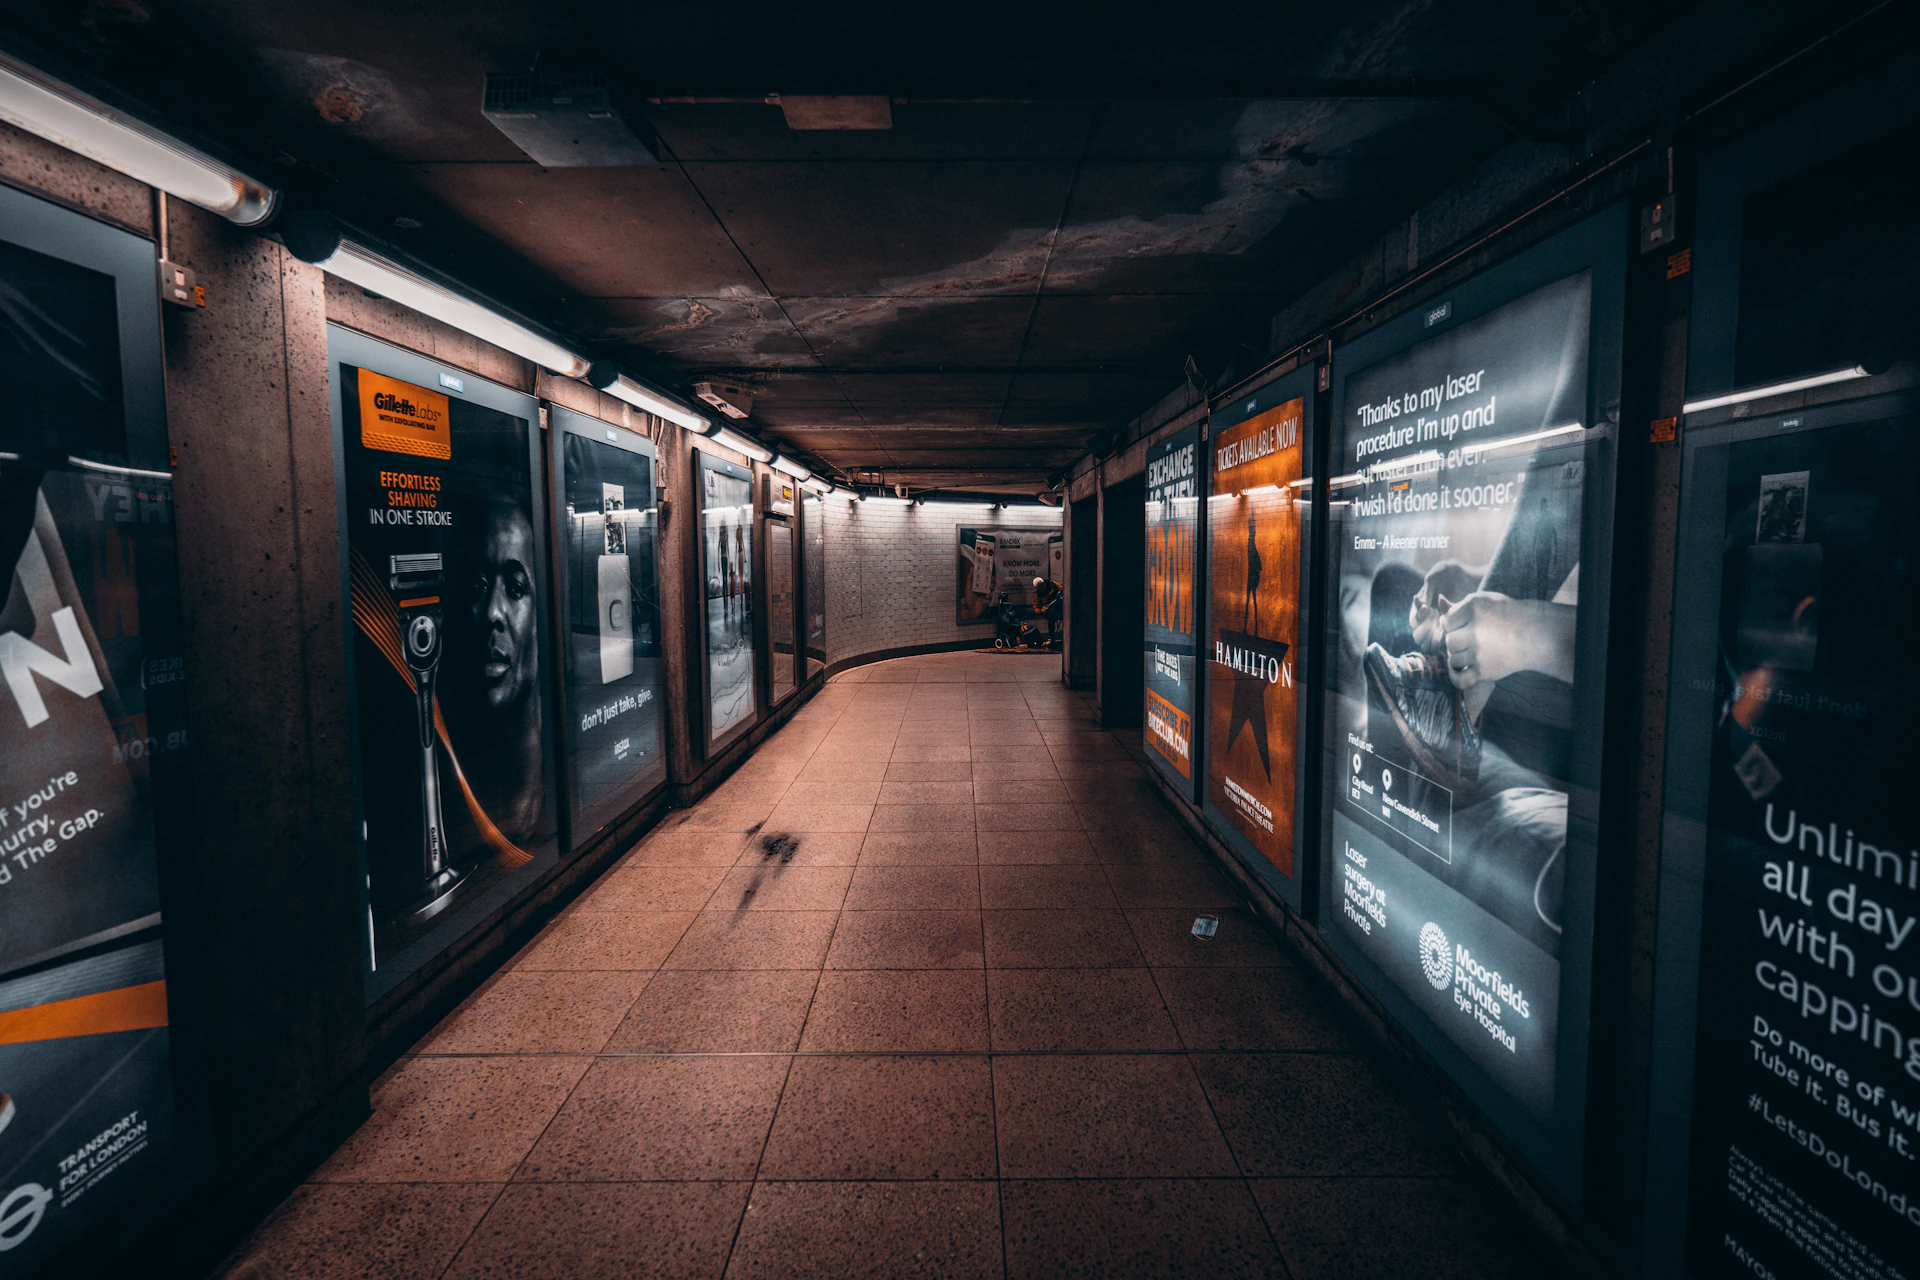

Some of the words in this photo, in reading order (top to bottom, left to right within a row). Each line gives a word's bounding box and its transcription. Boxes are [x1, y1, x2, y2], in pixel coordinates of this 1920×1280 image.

[1403, 392, 1418, 415] to
[1420, 383, 1444, 412] my
[1445, 369, 1485, 401] laser
[378, 413, 394, 423] WITH
[394, 416, 426, 429] EXFOLIATING
[426, 423, 436, 431] BAR
[1217, 441, 1238, 472] TICKETS
[1239, 425, 1275, 465] AVAILABLE
[1276, 416, 1298, 451] NOW
[1355, 425, 1414, 463] procedure
[1416, 417, 1438, 443] I'm
[1440, 414, 1459, 441] up
[1461, 395, 1496, 431] and
[380, 470, 441, 492] EFFORTLESS
[1148, 443, 1194, 489] EXCHANGE
[369, 508, 384, 525] IN
[386, 508, 414, 525] ONE
[416, 510, 453, 526] STROKE
[388, 491, 438, 509] SHAVING
[1164, 478, 1195, 520] THEY
[1359, 492, 1386, 516] wish
[1387, 490, 1401, 514] I'd
[1404, 488, 1438, 513] done
[1440, 485, 1451, 509] it
[1354, 535, 1376, 550] Emma
[1382, 535, 1390, 549] A
[1390, 535, 1418, 549] keener
[1420, 535, 1450, 549] runner
[1008, 570, 1018, 578] DO
[1147, 521, 1193, 636] GROW
[1215, 640, 1292, 689] HAMILTON
[581, 708, 603, 732] don't
[603, 701, 619, 725] just
[619, 695, 637, 714] take,
[637, 689, 653, 708] give.
[1148, 693, 1178, 733] SUBSCRIBE
[1180, 717, 1189, 742] AT
[1148, 710, 1189, 761] BIKECLUB.COM
[1348, 732, 1360, 744] Find
[1360, 740, 1366, 749] us
[14, 770, 80, 822] you're
[1351, 775, 1361, 788] City
[1361, 780, 1374, 795] Road
[1241, 799, 1255, 819] PALACE
[1254, 811, 1274, 834] THEATRE
[1382, 792, 1394, 805] New
[1394, 798, 1421, 824] Cavendish
[1420, 813, 1440, 834] Street
[13, 837, 58, 870] The
[58, 808, 105, 840] Gap.
[1345, 840, 1368, 869] Laser
[1344, 863, 1376, 900] surgery
[1375, 888, 1386, 906] at
[1344, 879, 1387, 928] Moorfields
[1761, 859, 1814, 907] all
[1826, 882, 1918, 952] day
[1343, 898, 1371, 936] Private
[1757, 907, 1856, 980] with
[1454, 964, 1501, 1020] Private
[1455, 943, 1530, 1019] Moorfields
[1453, 986, 1472, 1015] Eye
[1474, 1003, 1516, 1054] Hospital
[1752, 1014, 1784, 1047] Do
[1788, 1039, 1850, 1089] more
[1855, 1080, 1886, 1107] of
[1749, 1039, 1801, 1088] Tube
[1804, 1074, 1828, 1106] it.
[1835, 1092, 1881, 1139] Bus
[1887, 1125, 1916, 1161] it.
[57, 1110, 139, 1174] TRANSPORT
[59, 1163, 89, 1192] FOR
[89, 1119, 148, 1170] LONDON
